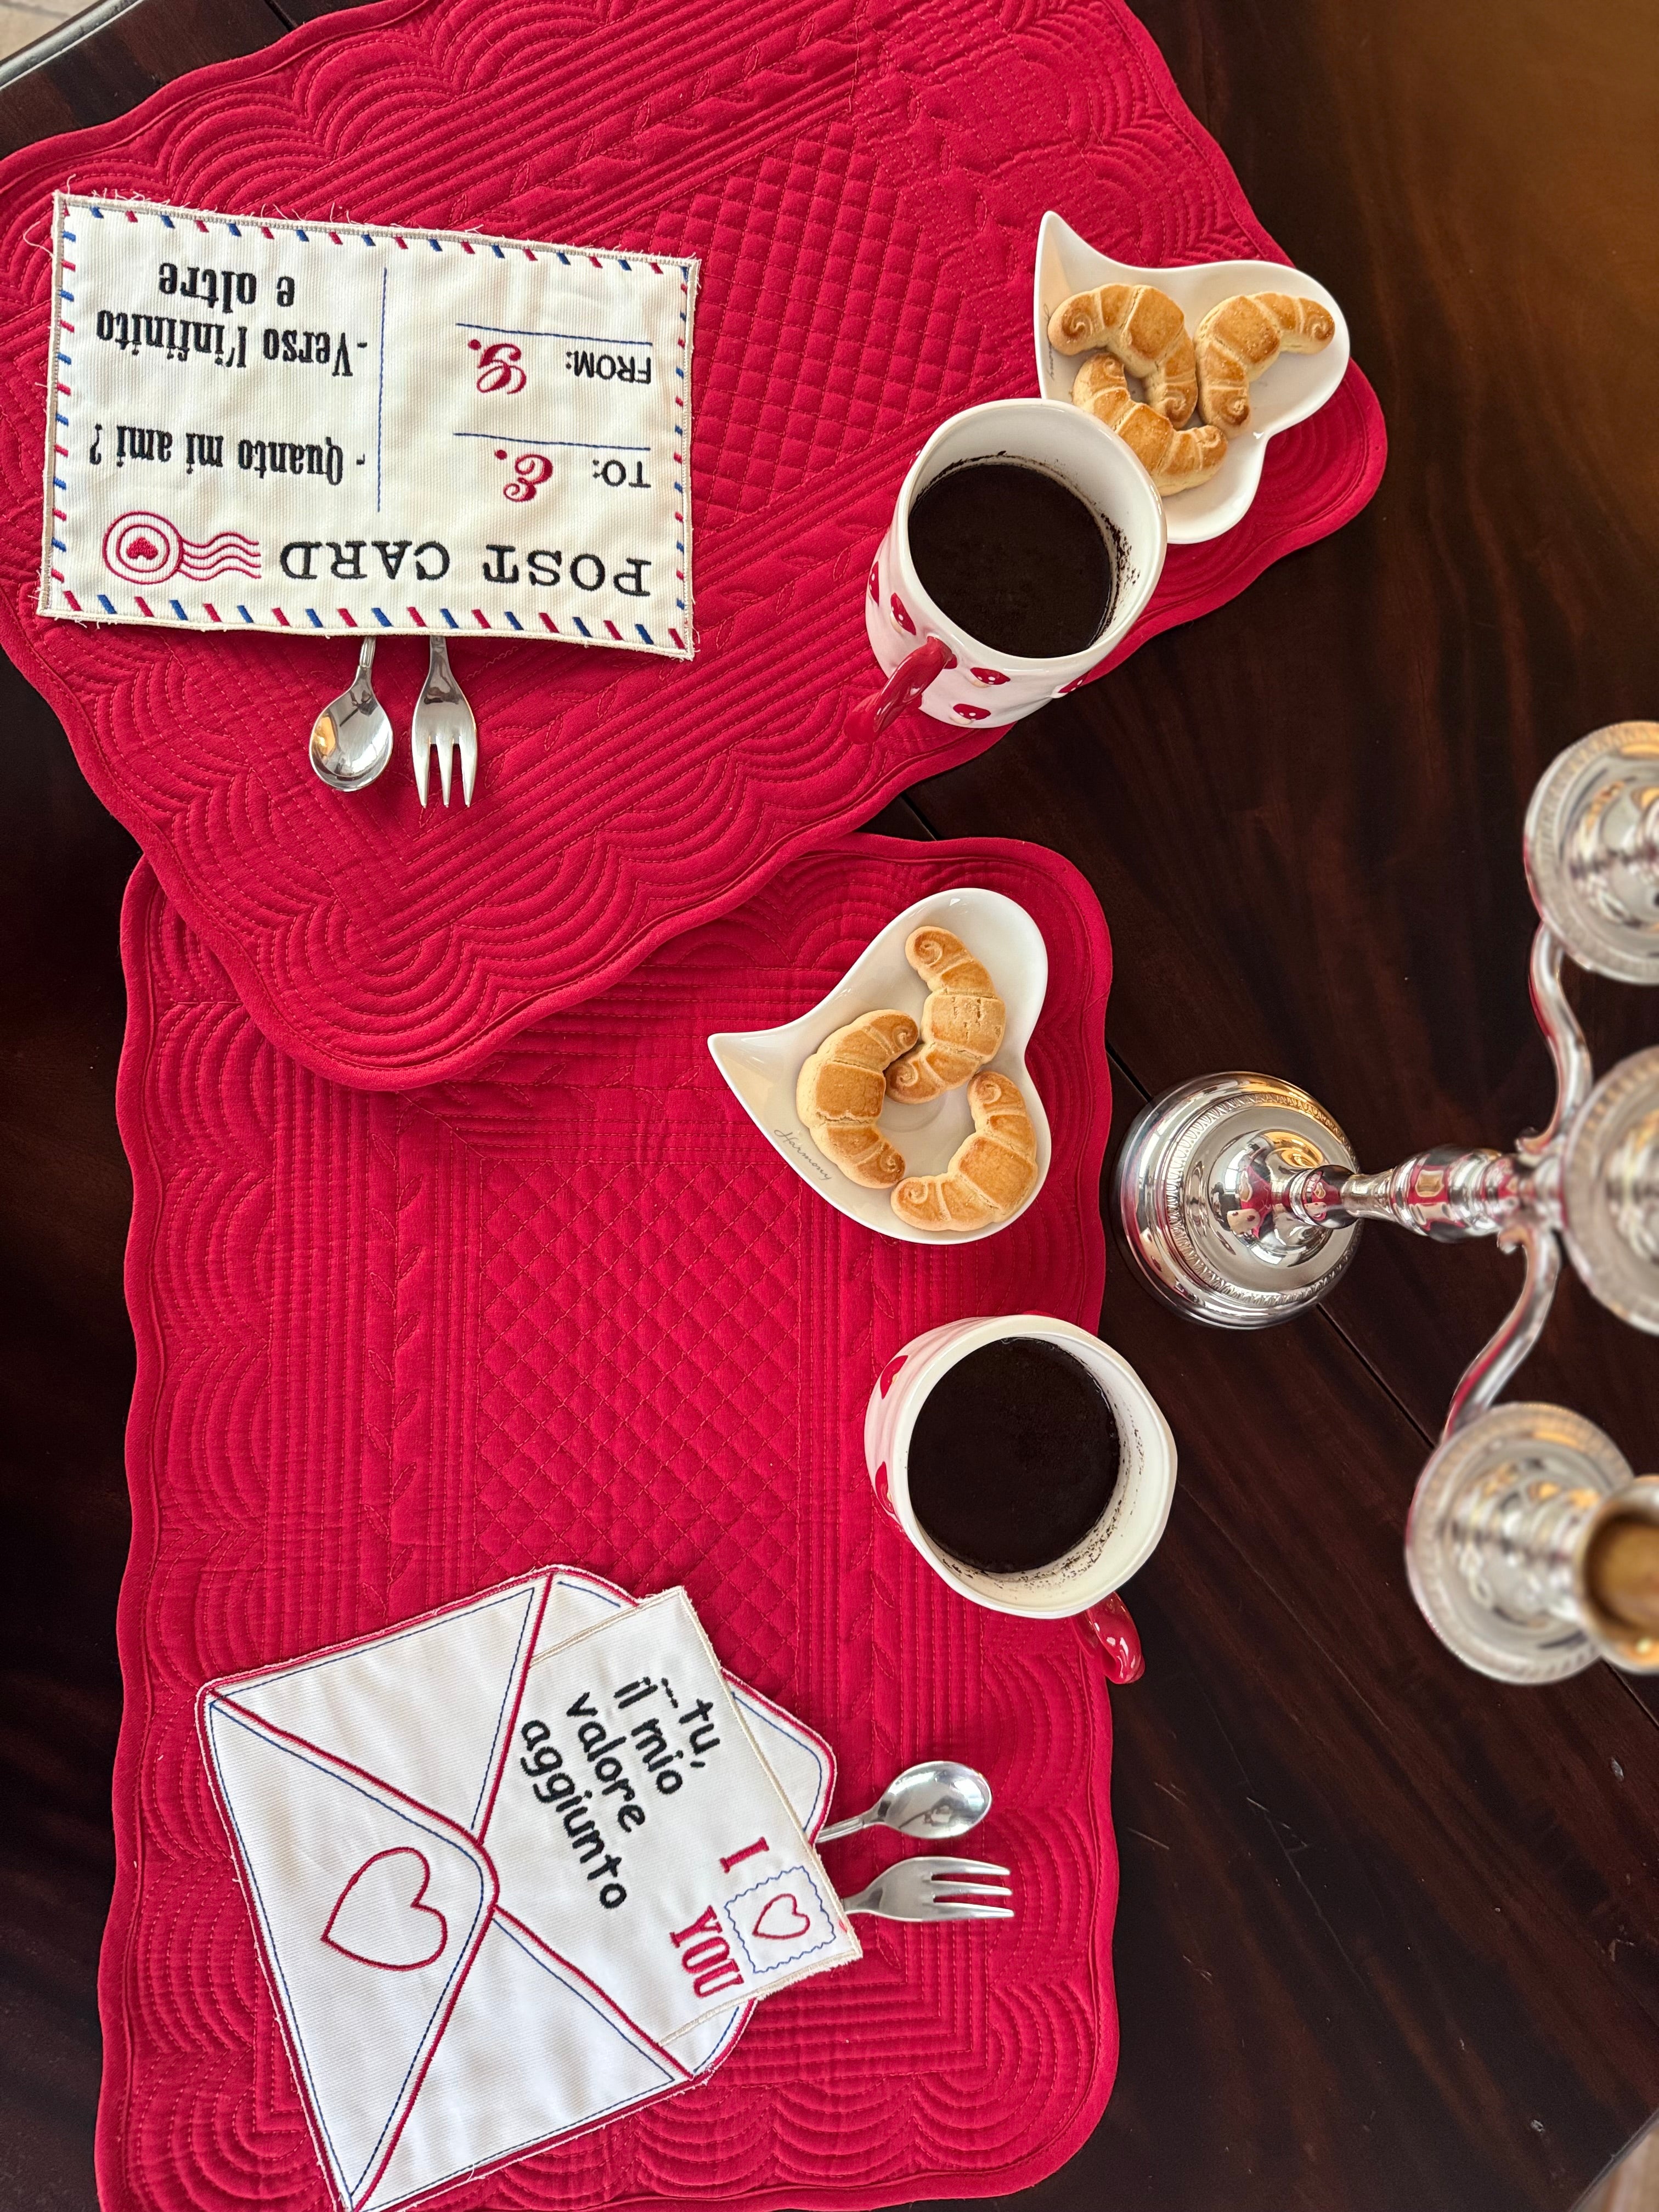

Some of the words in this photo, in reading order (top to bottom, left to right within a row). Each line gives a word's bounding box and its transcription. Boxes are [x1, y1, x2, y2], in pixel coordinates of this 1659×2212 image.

[159, 263, 256, 314] oltre
[276, 276, 295, 307] e
[97, 310, 247, 368] l'infinito
[566, 351, 651, 384] FROM:
[116, 425, 172, 467] ami
[186, 433, 223, 473] mi
[238, 437, 343, 486] Quanto
[592, 460, 651, 488] TO:
[280, 540, 450, 580] CARD
[483, 544, 651, 596] POST
[774, 1129, 832, 1181] Harmony
[614, 1677, 658, 1709] il
[566, 1692, 645, 1833] valore
[632, 1718, 684, 1795] mio
[521, 1720, 627, 1909] aggiunto
[720, 1837, 769, 1873] I
[670, 1905, 744, 1997] YOU
